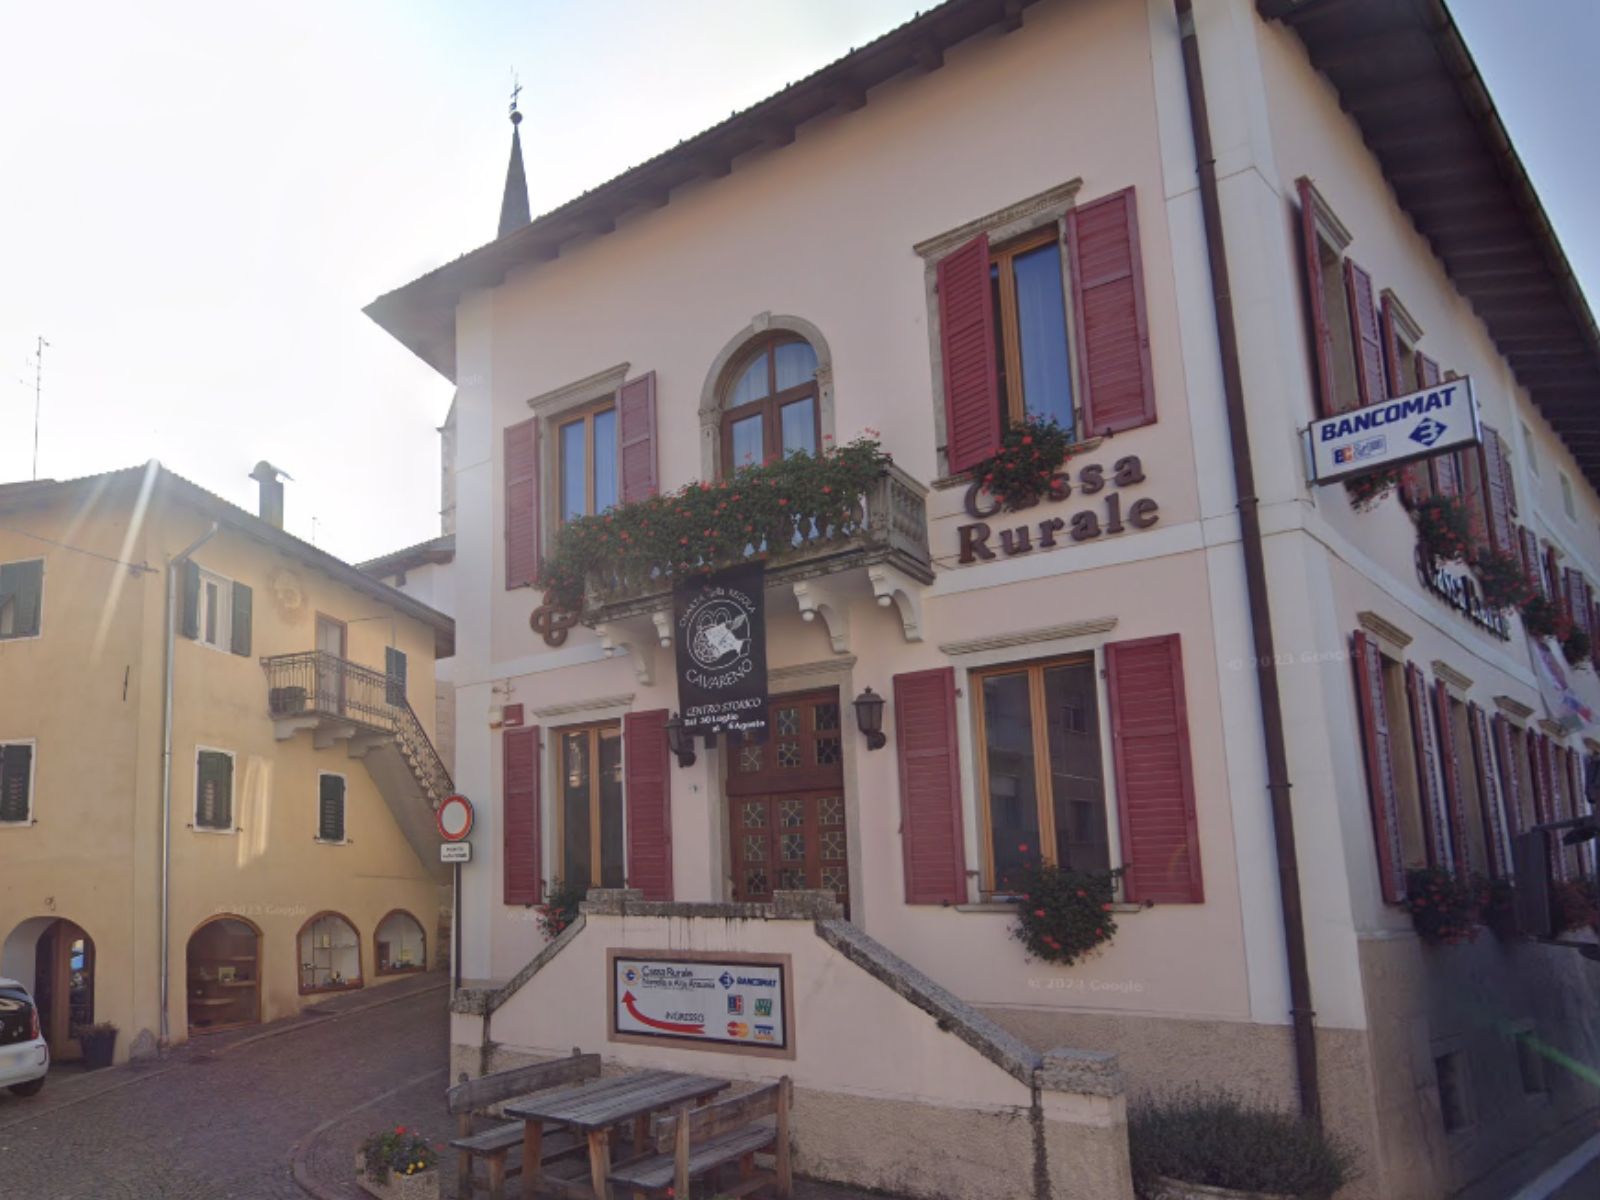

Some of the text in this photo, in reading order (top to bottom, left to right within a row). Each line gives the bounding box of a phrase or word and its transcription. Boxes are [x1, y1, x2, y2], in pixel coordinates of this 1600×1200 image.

[1321, 386, 1457, 442] BANCOMAT
[957, 492, 1160, 564] Rurale
[686, 658, 752, 689] CAVARENO
[686, 697, 761, 716] CENTRO STORICO
[712, 713, 739, 722] Luglio
[735, 720, 765, 730] Agosto
[666, 968, 693, 978] Rurale
[736, 976, 777, 988] BANCOMAT
[665, 1011, 704, 1023] INGRESSO
